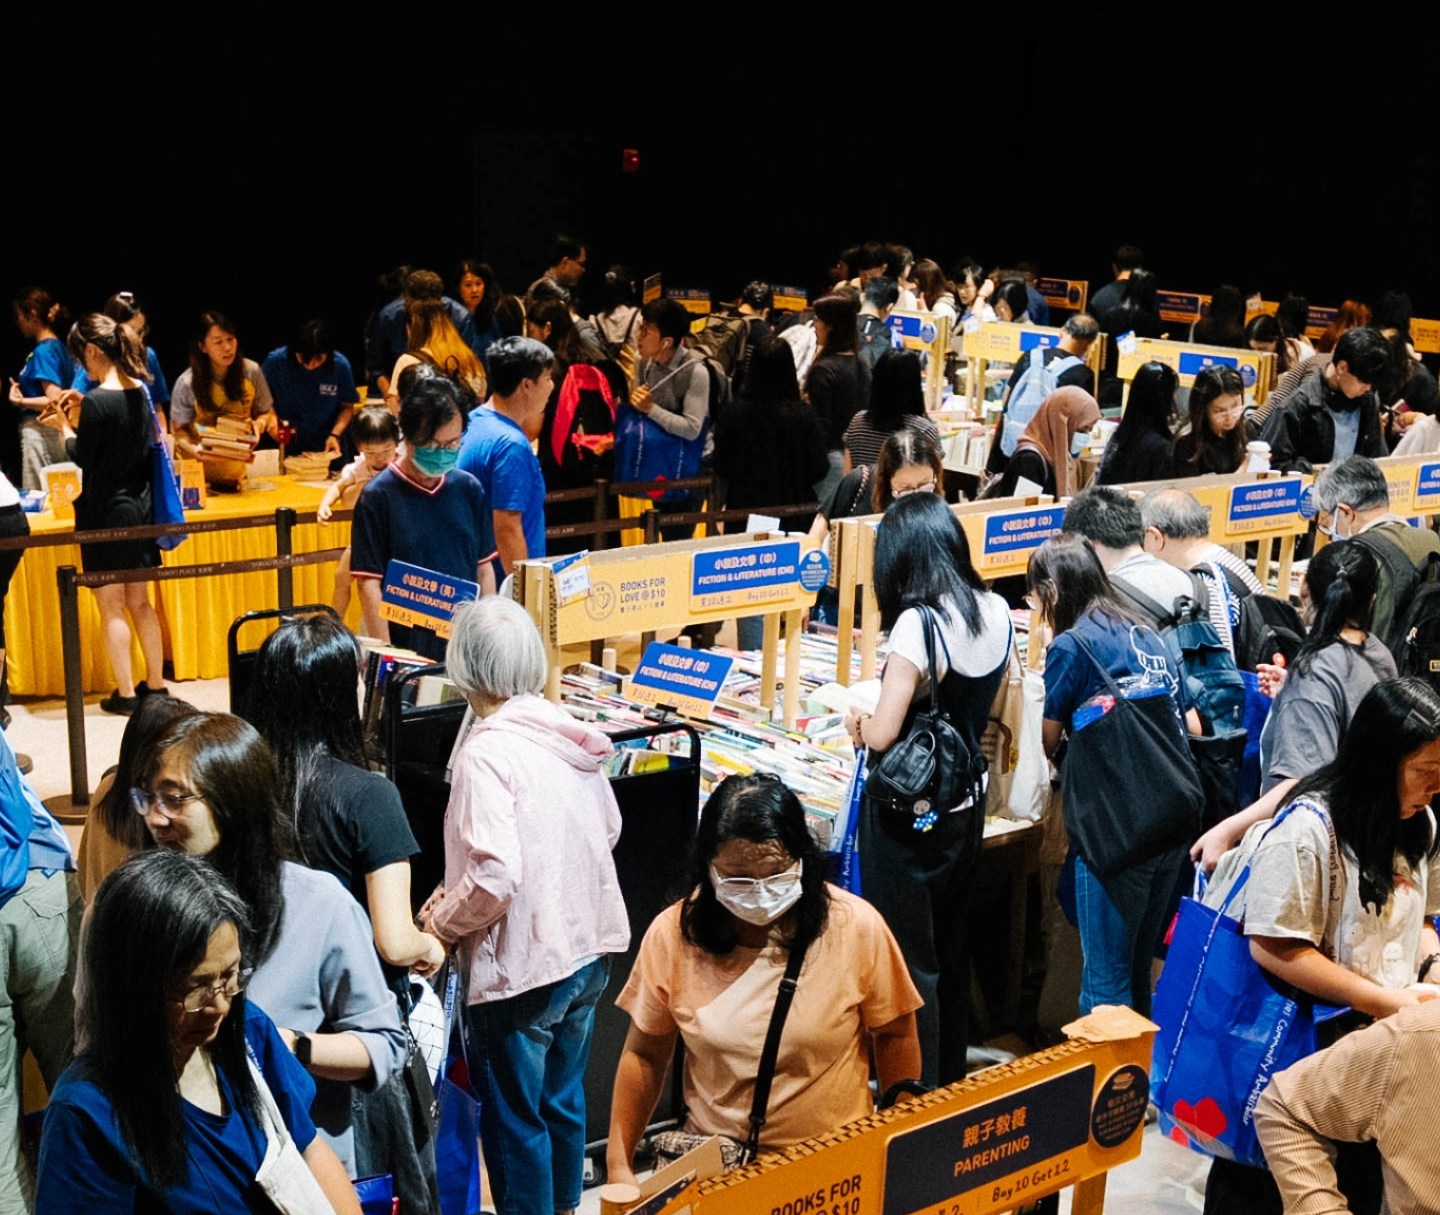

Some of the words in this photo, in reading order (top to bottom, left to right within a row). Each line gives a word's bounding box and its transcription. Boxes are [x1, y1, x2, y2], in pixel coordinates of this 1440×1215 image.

[621, 578, 647, 593] BOOKS
[649, 576, 666, 588] FOR
[698, 571, 725, 586] FICTION
[734, 567, 777, 583] LITERATURE
[620, 591, 640, 605] LOVE
[650, 588, 666, 600] $10
[962, 1106, 1027, 1149] 親子教養
[954, 1135, 1031, 1178] PARENTING
[830, 1174, 862, 1203] FOR
[992, 1185, 1013, 1204] Buy
[1014, 1175, 1030, 1195] 10
[1032, 1168, 1053, 1188] Get
